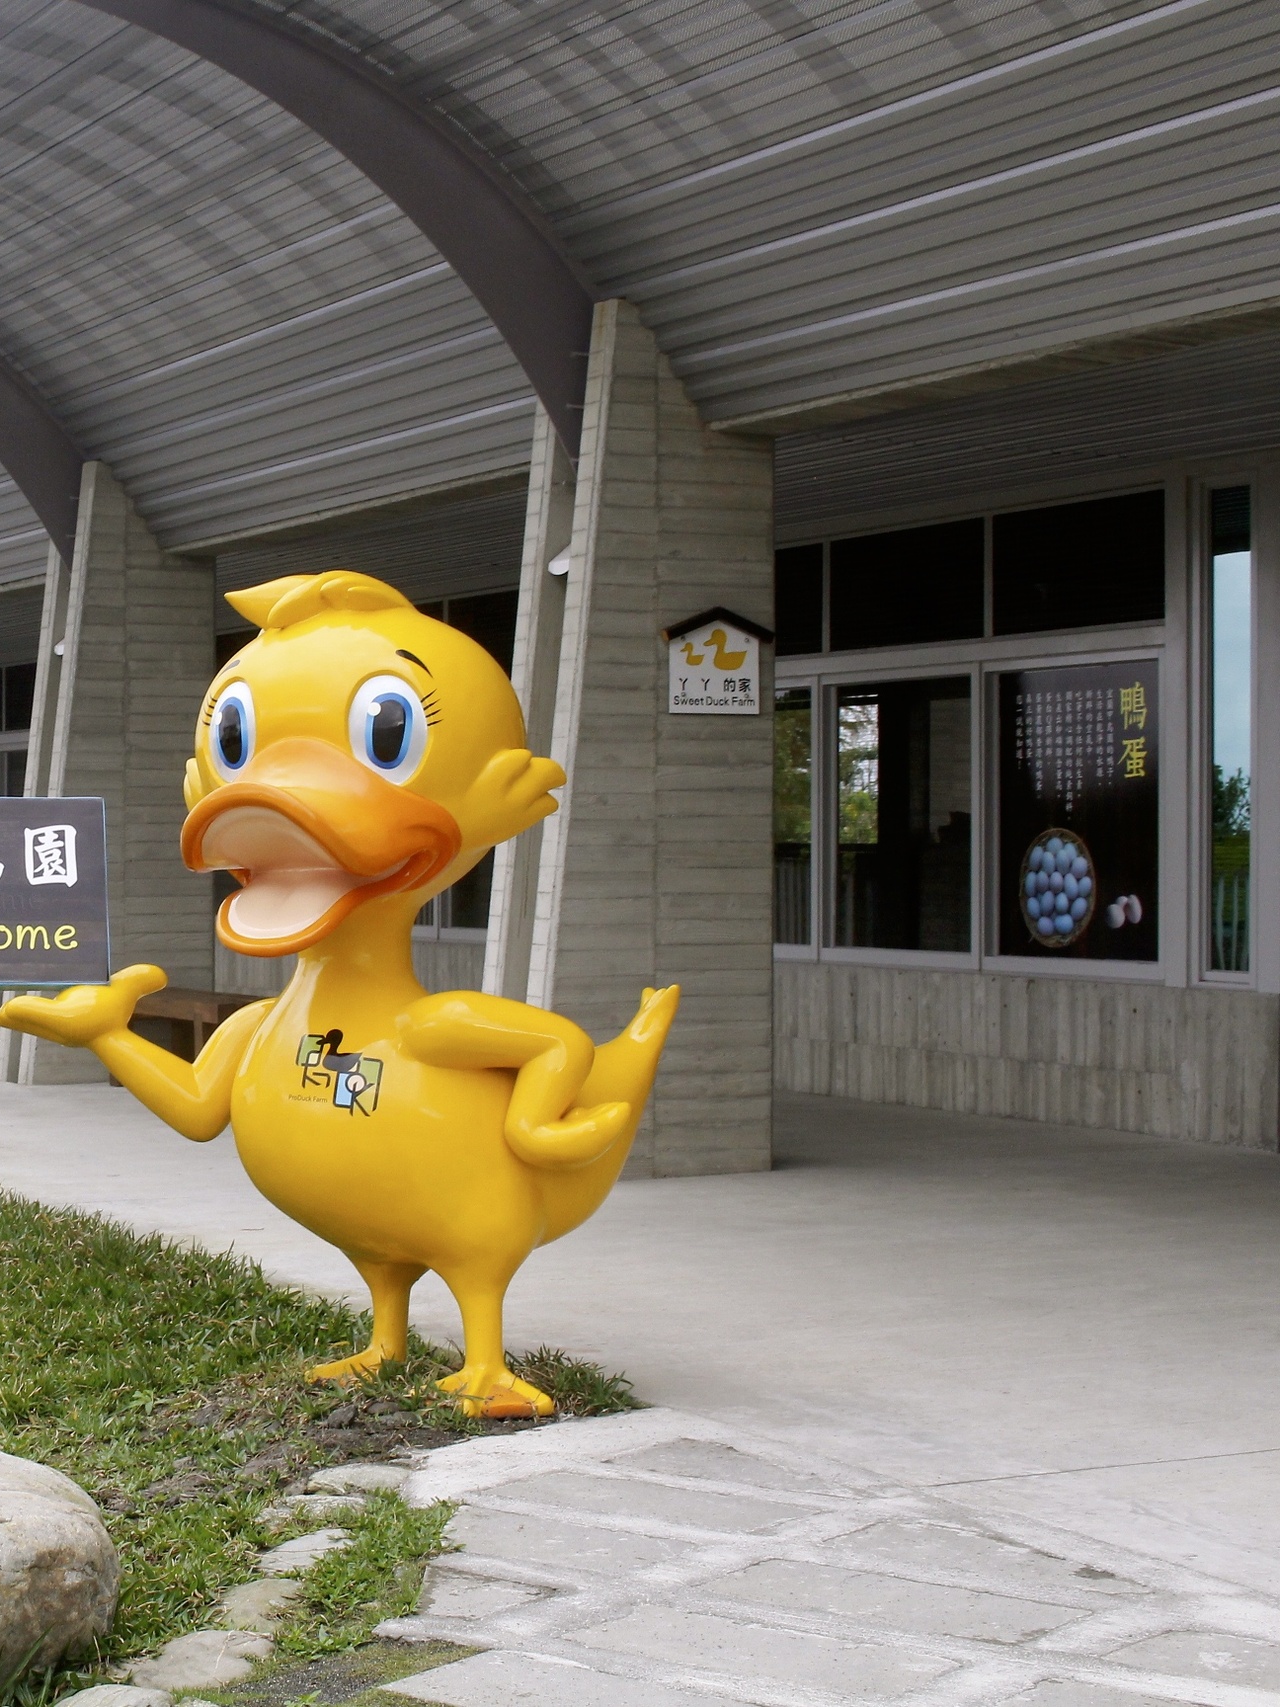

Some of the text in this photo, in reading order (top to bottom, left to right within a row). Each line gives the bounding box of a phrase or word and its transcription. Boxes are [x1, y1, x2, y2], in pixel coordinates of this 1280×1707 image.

[674, 695, 756, 707] Sweet Duck Farm
[1117, 681, 1148, 779] 鴨蛋
